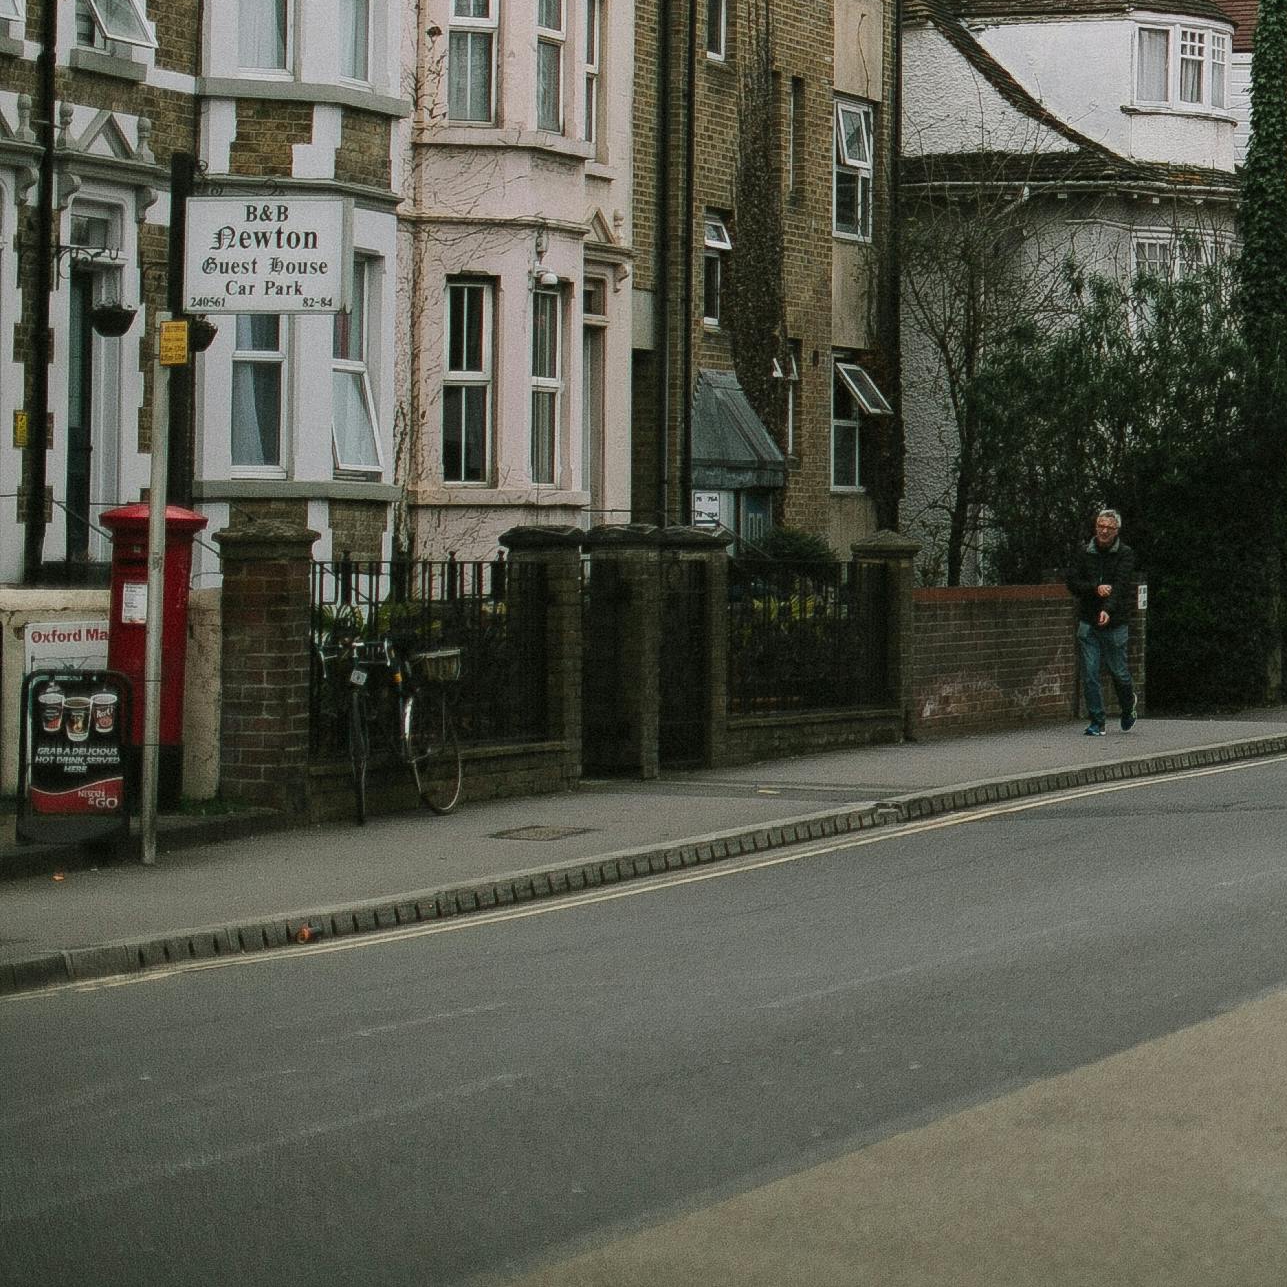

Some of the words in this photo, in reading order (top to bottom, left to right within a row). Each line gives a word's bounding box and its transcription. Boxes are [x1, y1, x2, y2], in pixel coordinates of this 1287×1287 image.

[245, 205, 289, 222] B&B
[209, 226, 319, 250] Newton
[202, 257, 258, 274] Guest
[269, 257, 328, 275] House
[225, 281, 256, 295] Car
[264, 281, 304, 295] Park
[190, 297, 226, 307] 240561
[302, 297, 333, 307] 82-84
[31, 629, 82, 644] Oxford
[72, 747, 118, 755] DELICIOUS
[95, 798, 118, 809] GO
